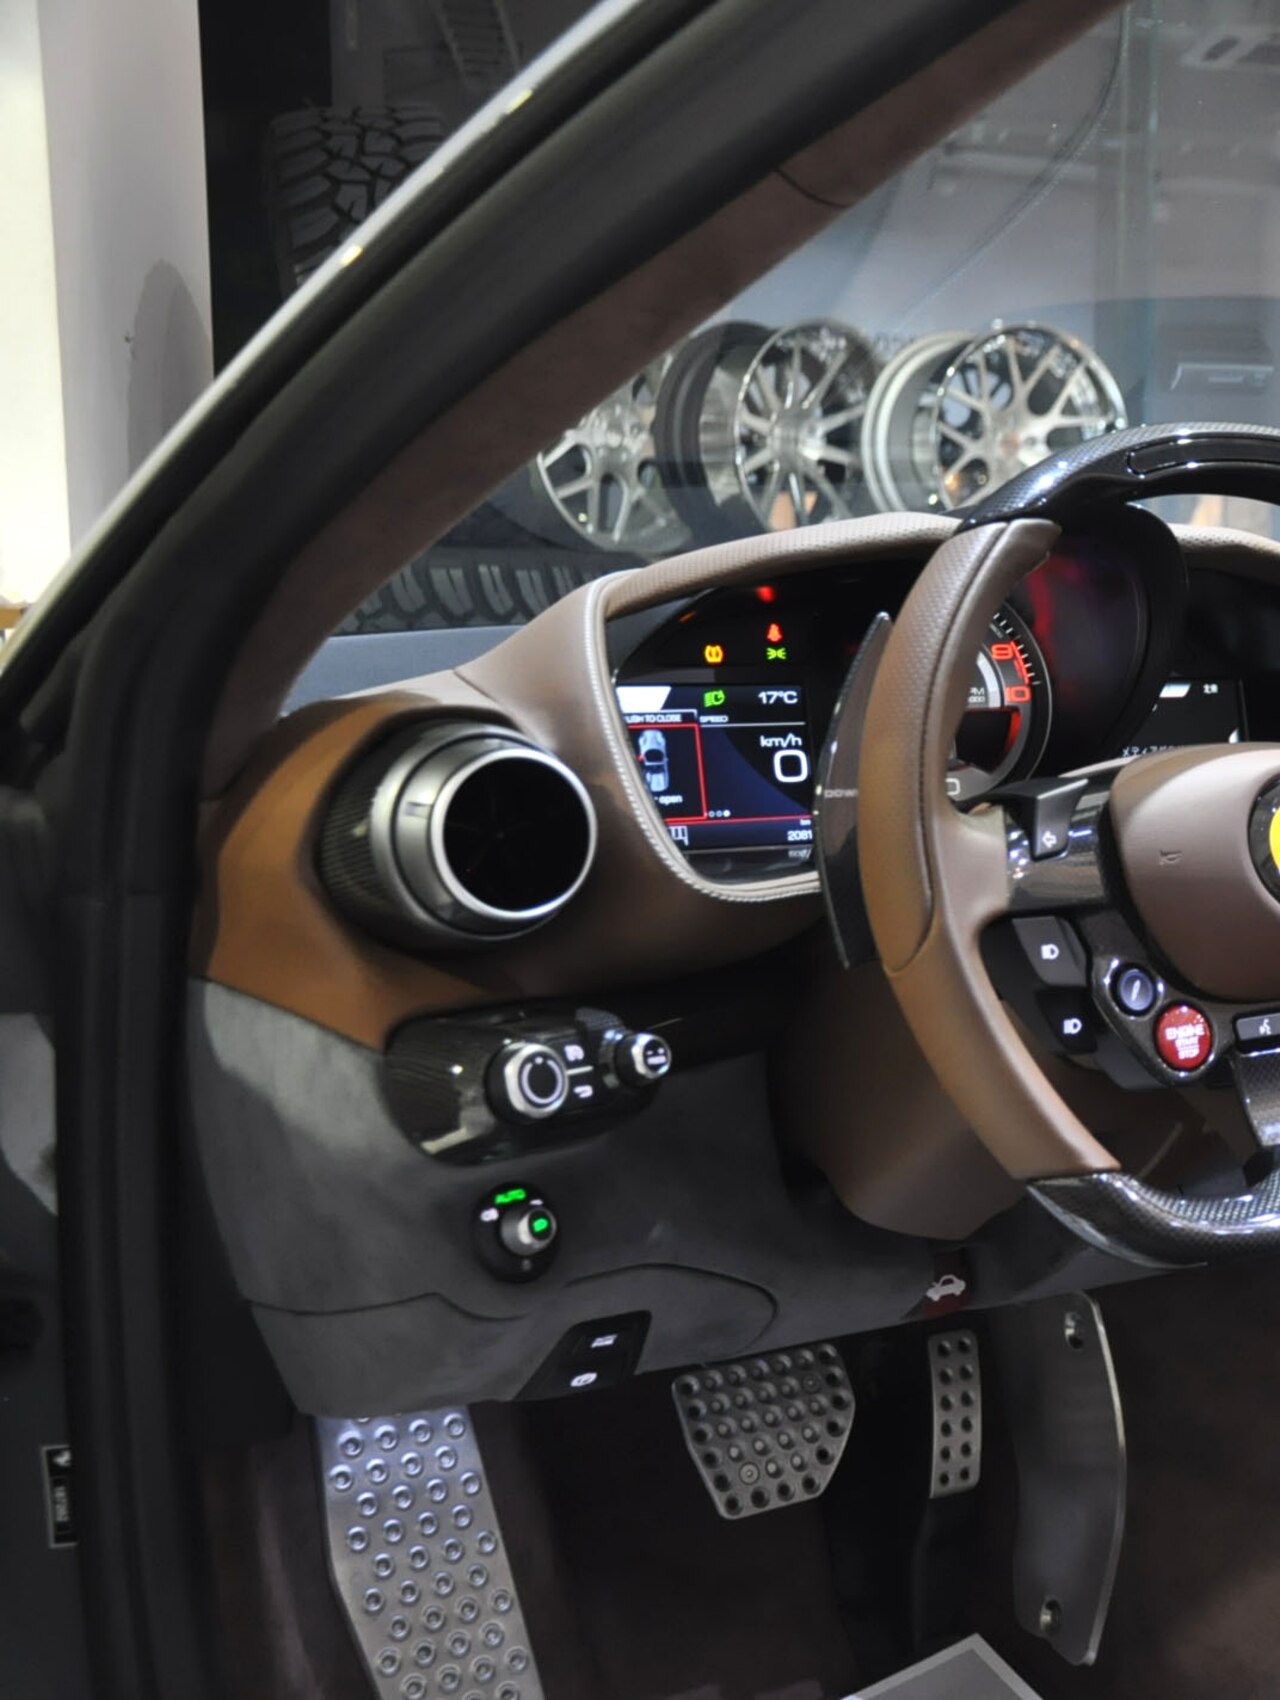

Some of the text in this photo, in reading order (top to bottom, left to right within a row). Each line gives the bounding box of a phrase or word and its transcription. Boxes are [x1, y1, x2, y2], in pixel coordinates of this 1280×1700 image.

[1005, 684, 1032, 703] 10
[760, 734, 802, 748] km/h
[774, 750, 808, 783] 0
